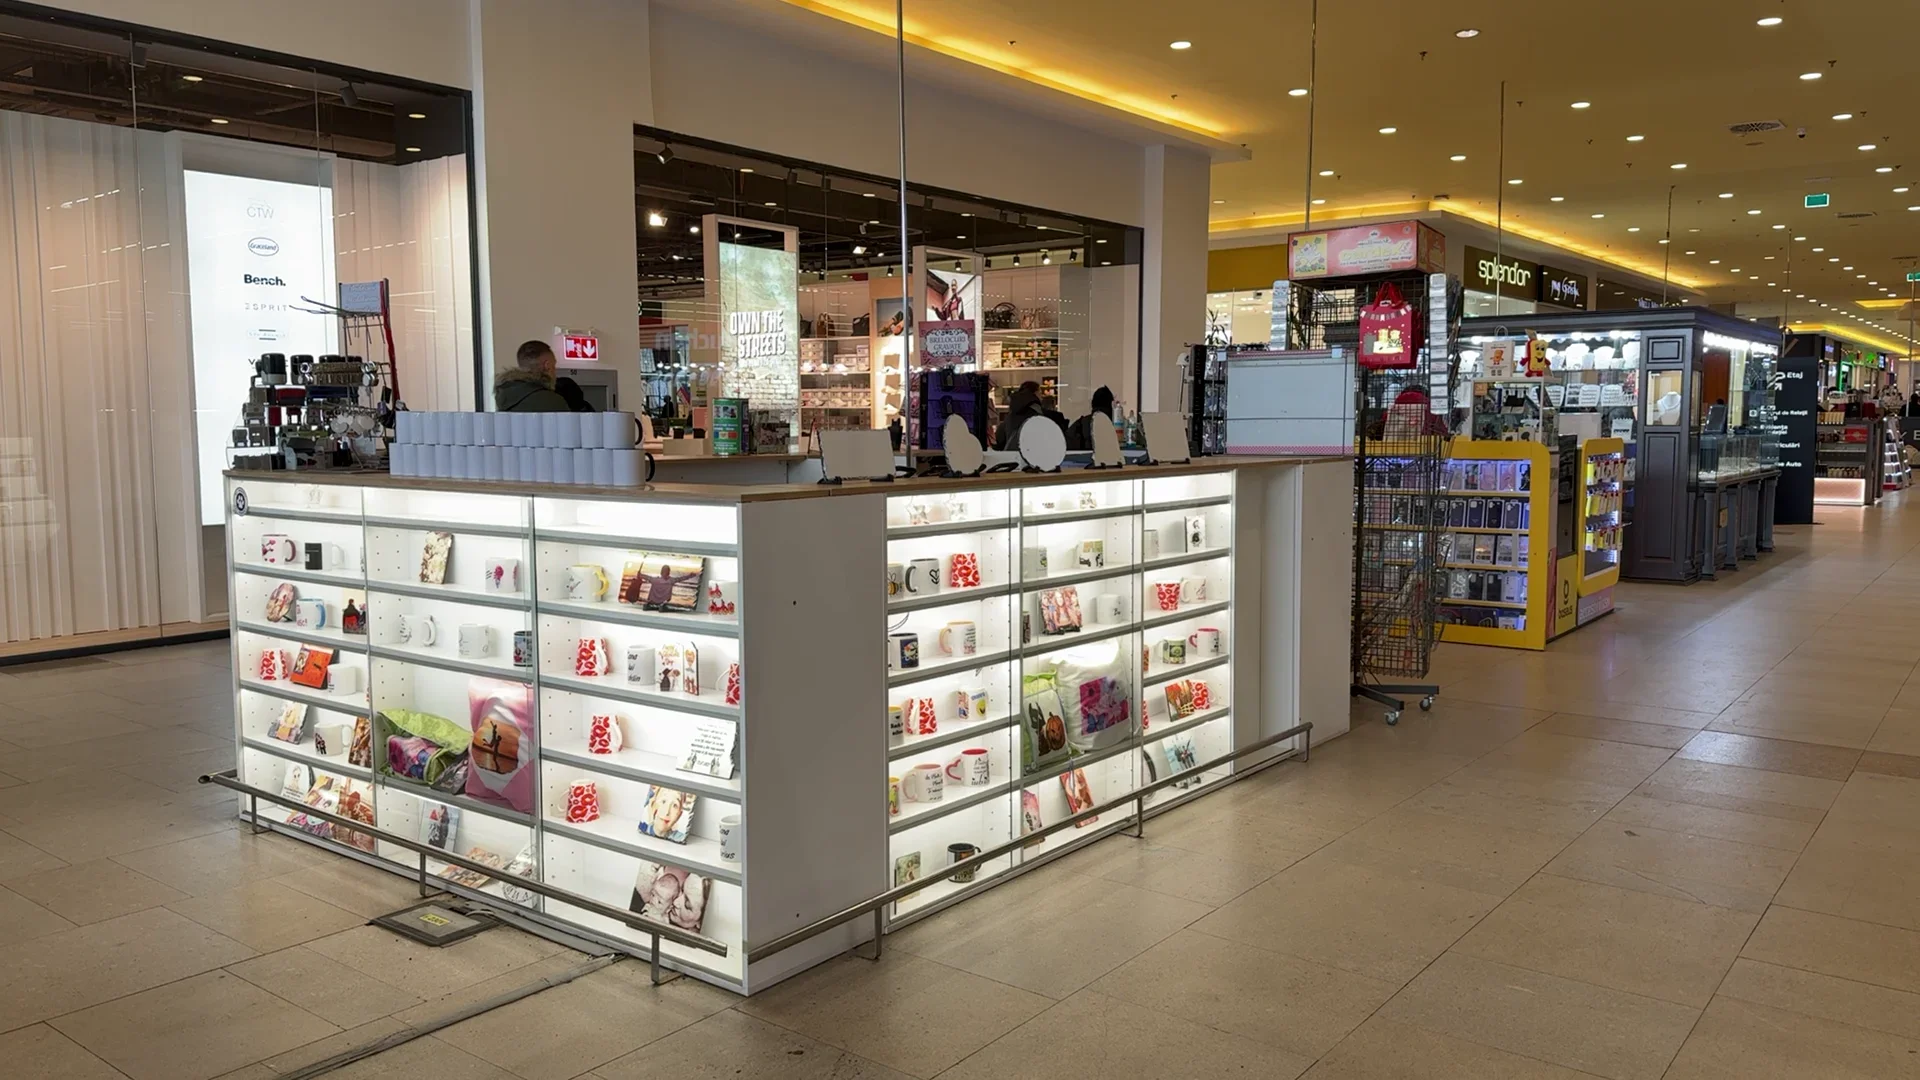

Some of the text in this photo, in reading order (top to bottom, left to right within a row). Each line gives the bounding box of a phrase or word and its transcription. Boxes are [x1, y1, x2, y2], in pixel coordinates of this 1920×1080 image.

[243, 274, 286, 287] Bench.
[729, 310, 784, 336] OWN THE
[738, 334, 787, 359] STREETS
[929, 336, 966, 344] BRELOCURI
[1786, 371, 1803, 380] Etaj
